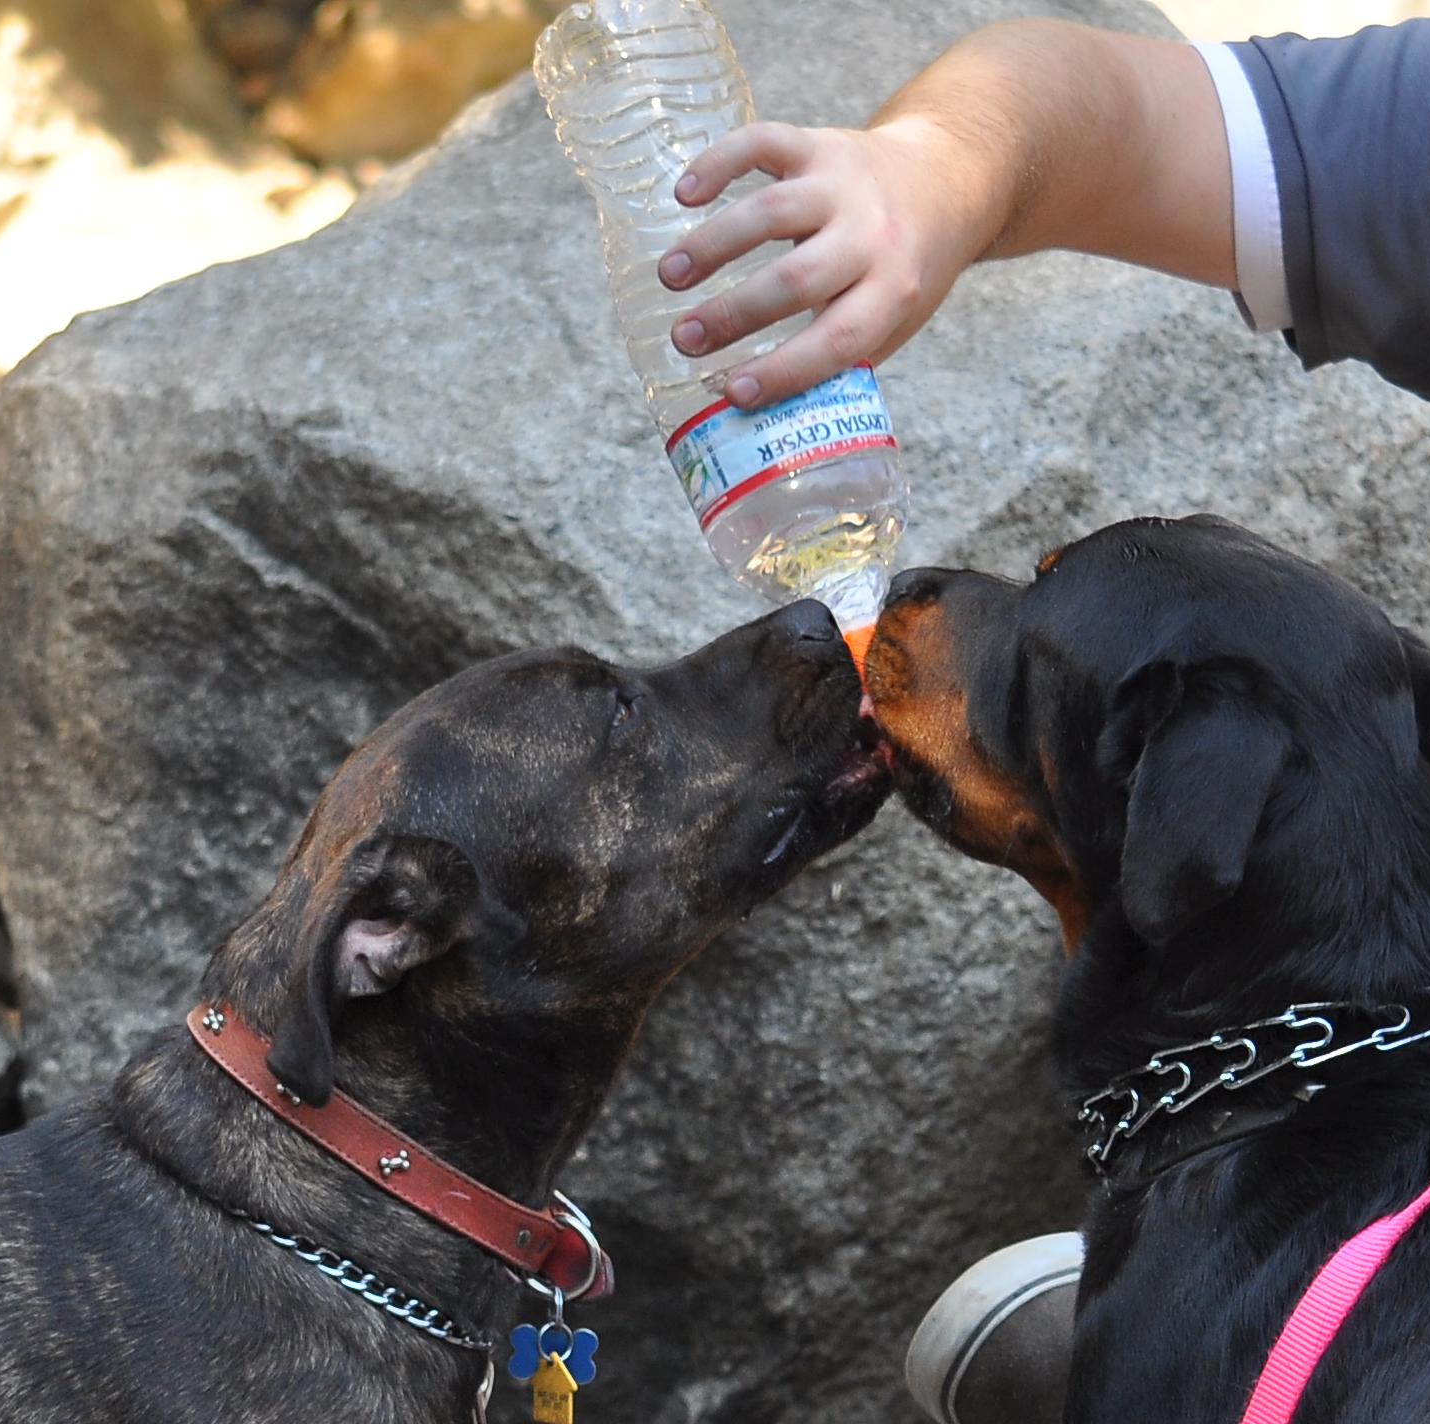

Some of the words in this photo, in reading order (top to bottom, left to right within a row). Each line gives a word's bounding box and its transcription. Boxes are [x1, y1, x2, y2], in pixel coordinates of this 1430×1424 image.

[796, 394, 841, 416] SPRING
[754, 409, 794, 433] WATER
[788, 405, 861, 429] NATURAL
[831, 413, 888, 435] CRYSTAL
[757, 422, 831, 462] GEYSER
[820, 443, 837, 453] THE
